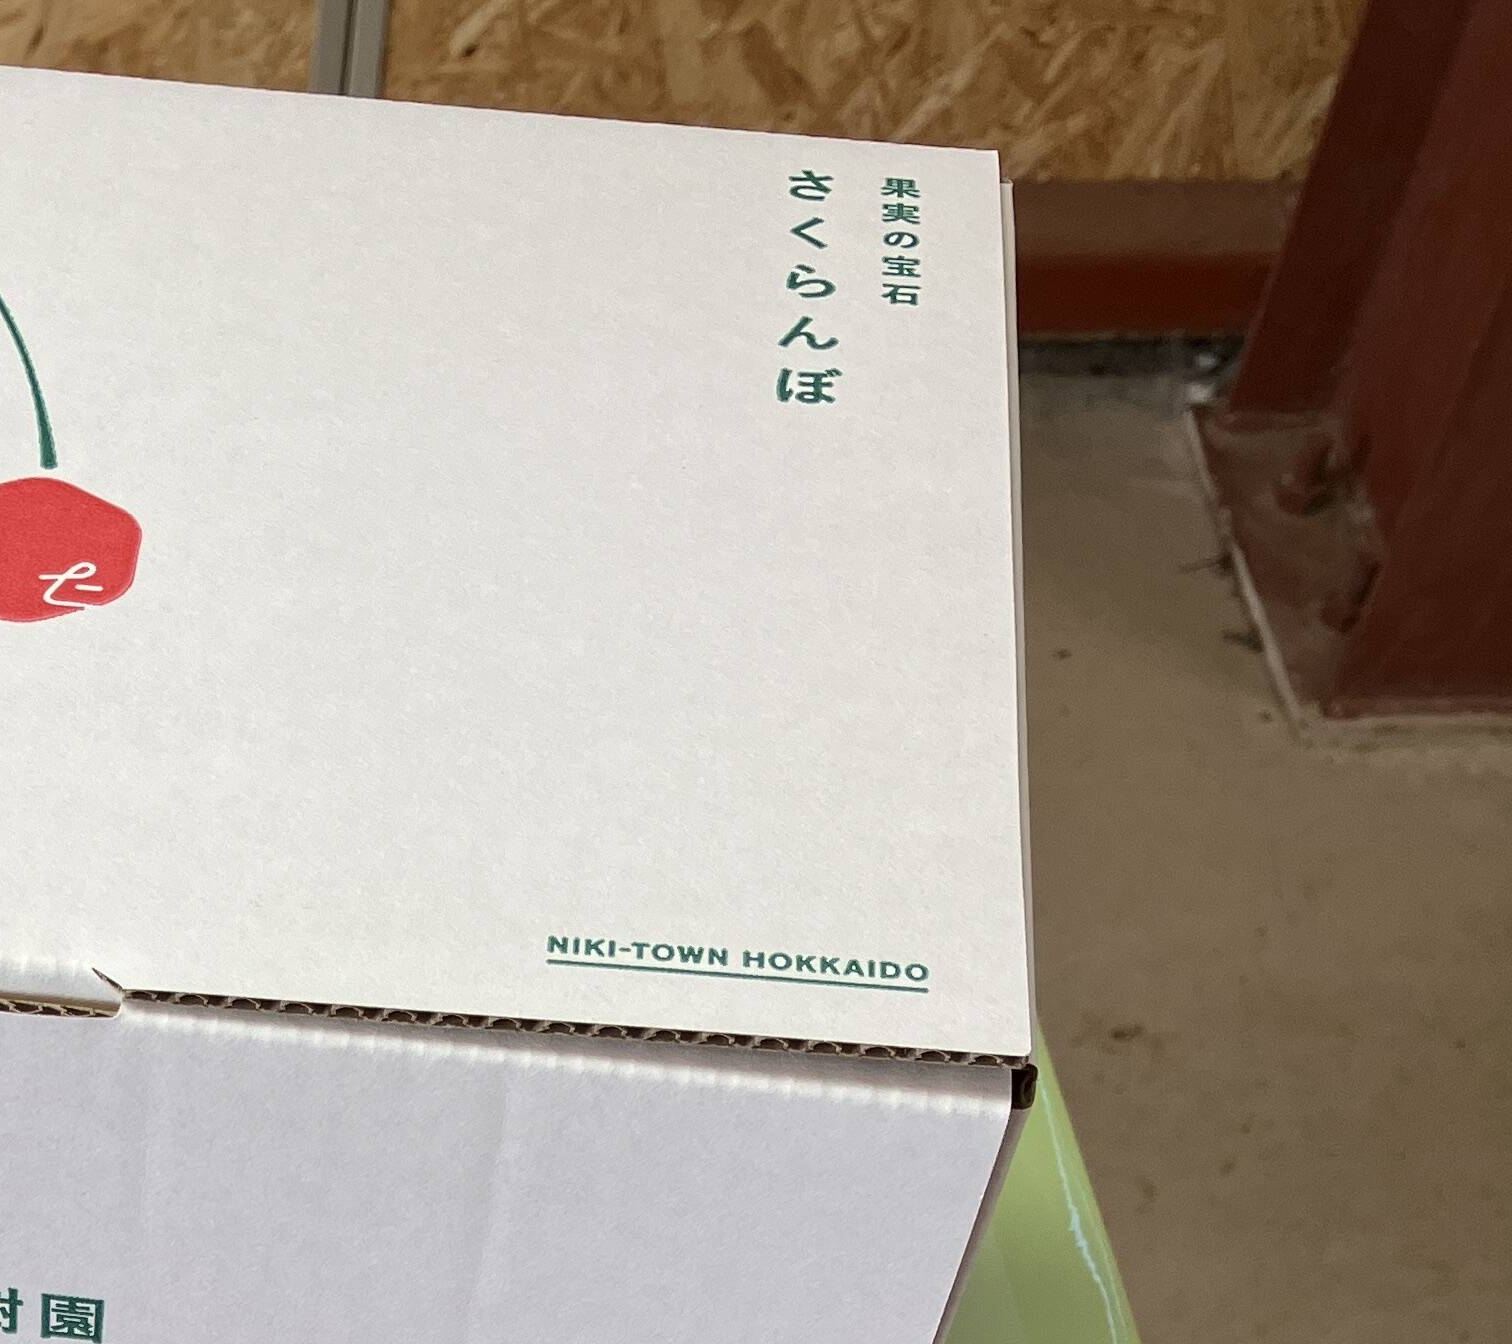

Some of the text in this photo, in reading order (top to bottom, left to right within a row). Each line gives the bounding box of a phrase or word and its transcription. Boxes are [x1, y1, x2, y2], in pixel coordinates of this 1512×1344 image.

[777, 170, 842, 403] さくらんぼ
[881, 178, 920, 305] 果実の宝石
[548, 936, 928, 981] NIKI-TOWN HOKKAIDO
